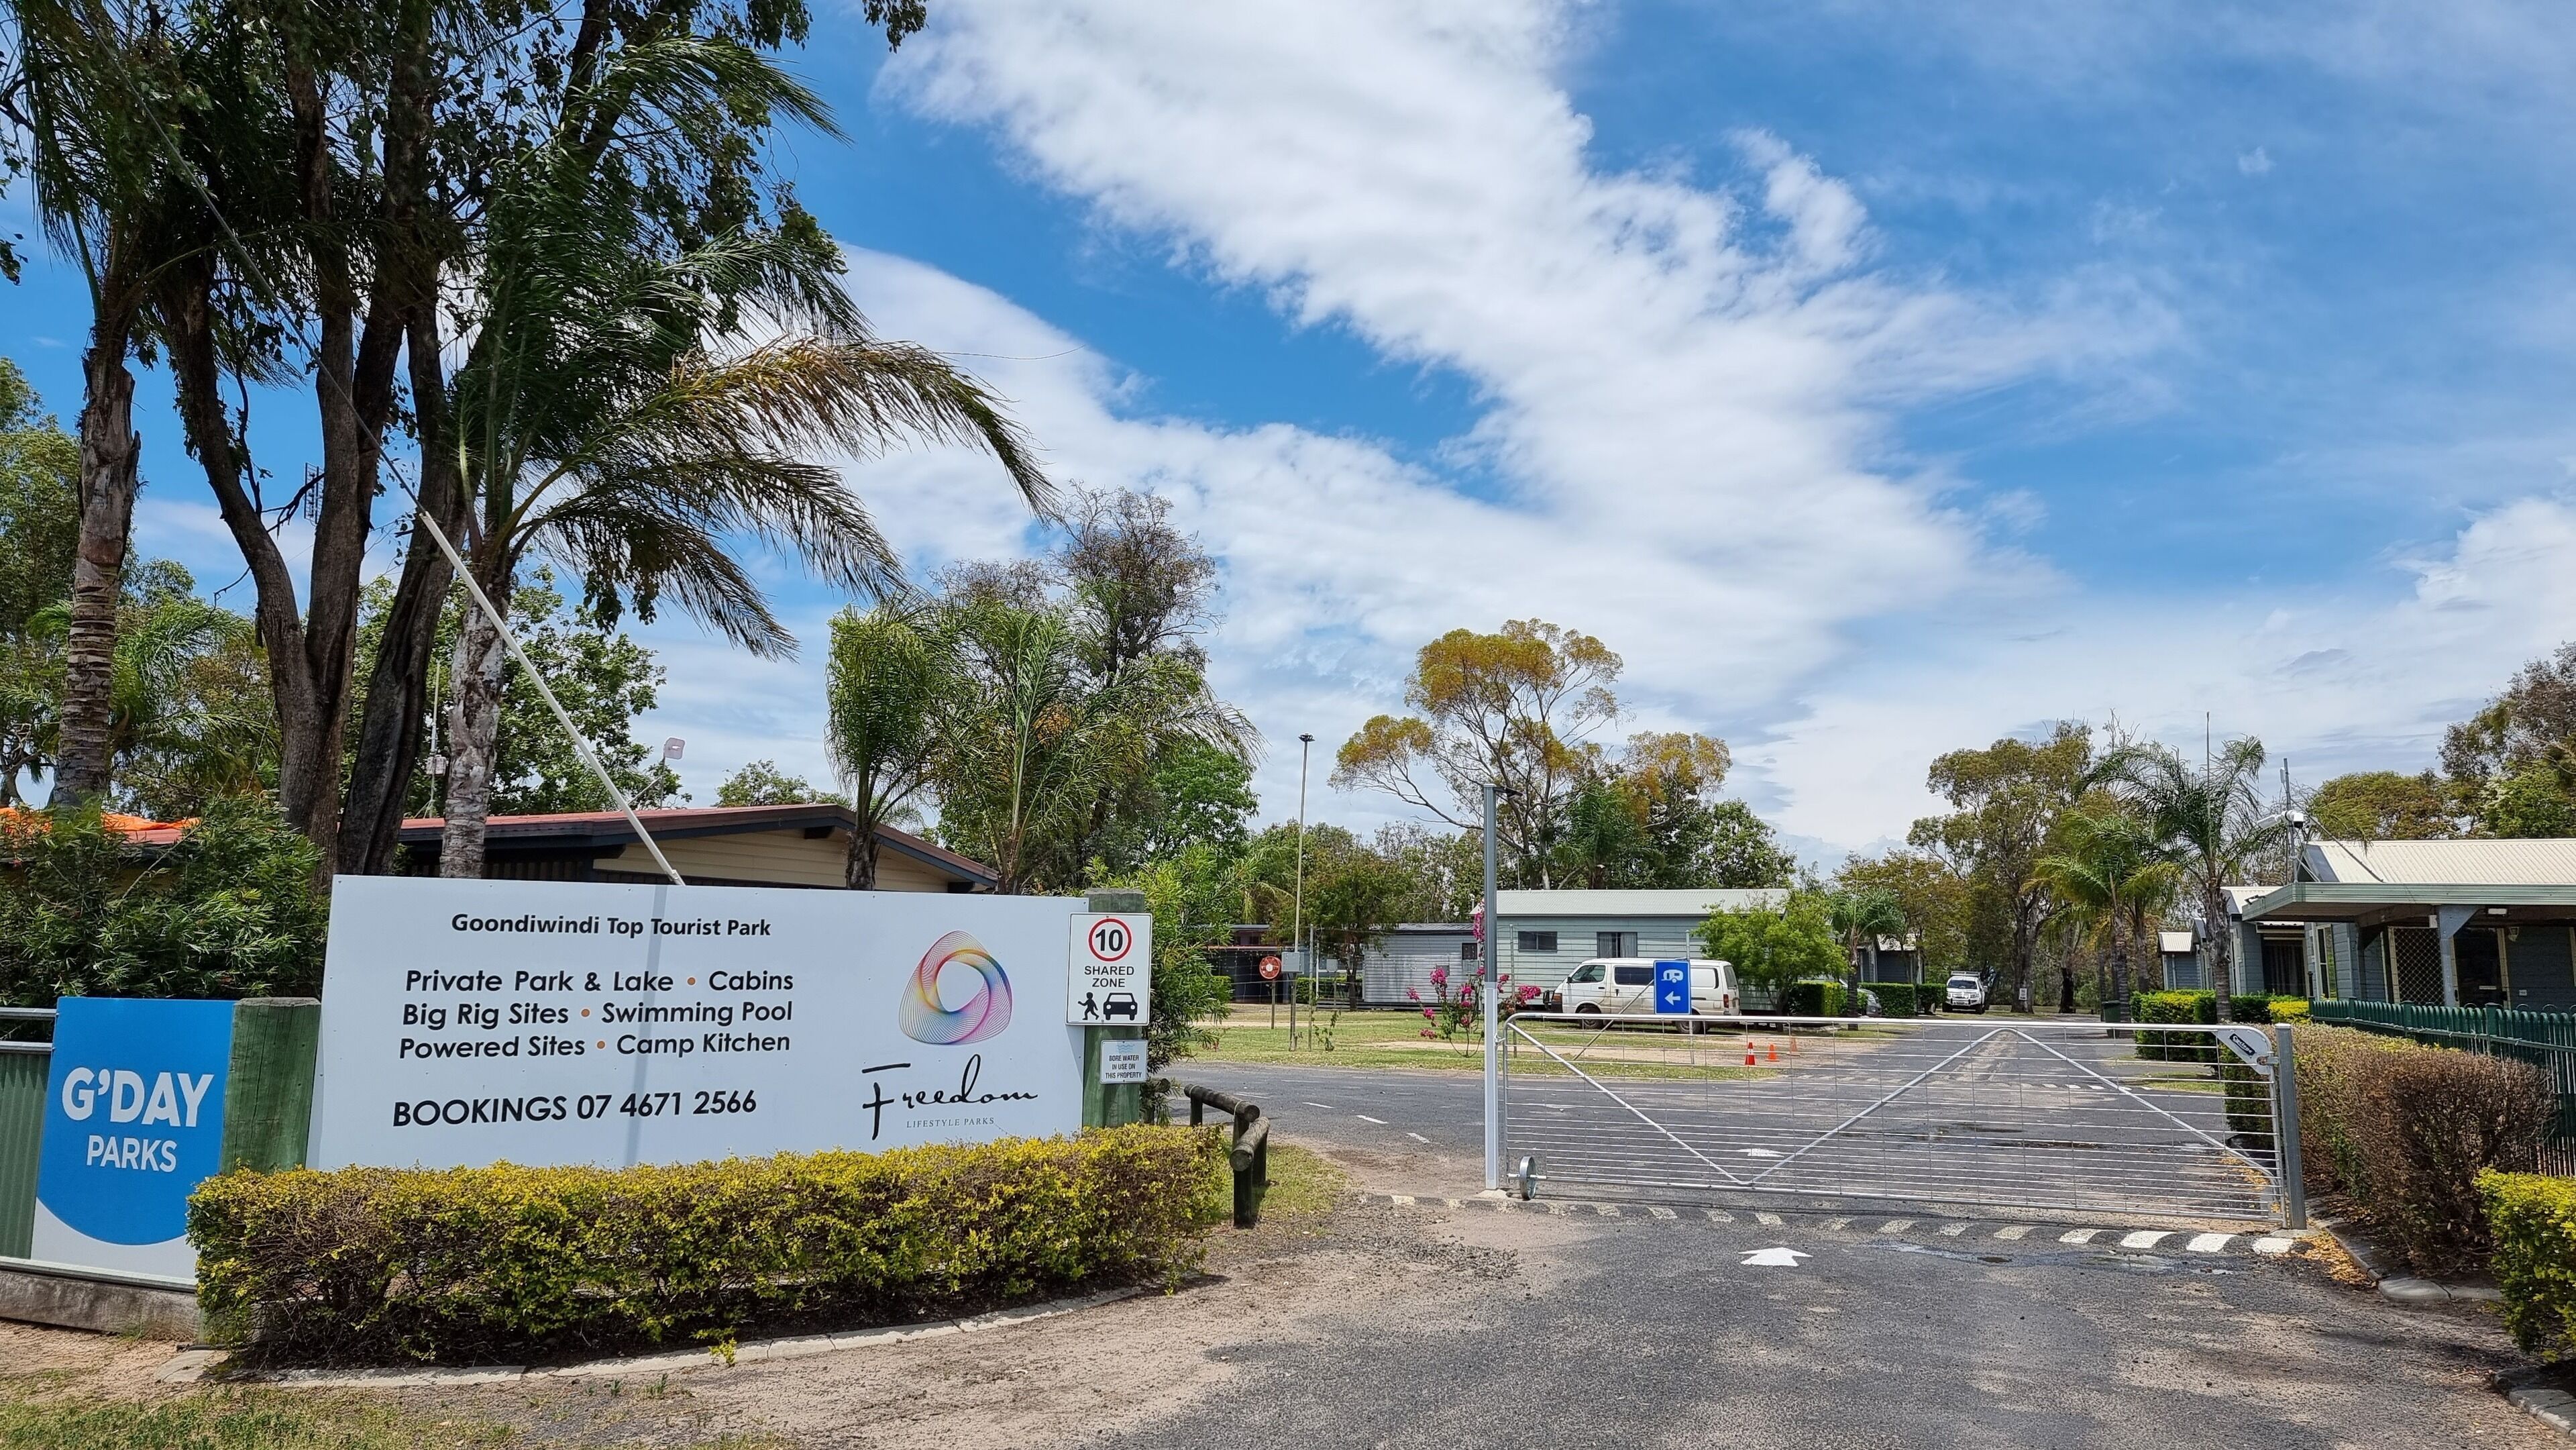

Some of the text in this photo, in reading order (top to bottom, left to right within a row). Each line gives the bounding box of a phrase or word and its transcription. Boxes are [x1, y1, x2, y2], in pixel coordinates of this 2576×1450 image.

[451, 913, 771, 939] Goondiwindi Top Tourist Park
[1095, 928, 1123, 951] 10
[406, 969, 794, 992] Private Park & Lake Cabins
[1084, 966, 1134, 976] SHARED
[1091, 978, 1126, 988] ZONE
[402, 1000, 792, 1029] Big Rig Sites Swimming Pool
[399, 1032, 790, 1059] Powered Sites Camp Kitchen
[392, 1089, 757, 1127] BOOKINGS 07 4671 2566
[861, 1053, 1039, 1141] Freedom
[906, 1117, 994, 1128] LIFESTYLE PARKS
[86, 1135, 178, 1173] PARKS
